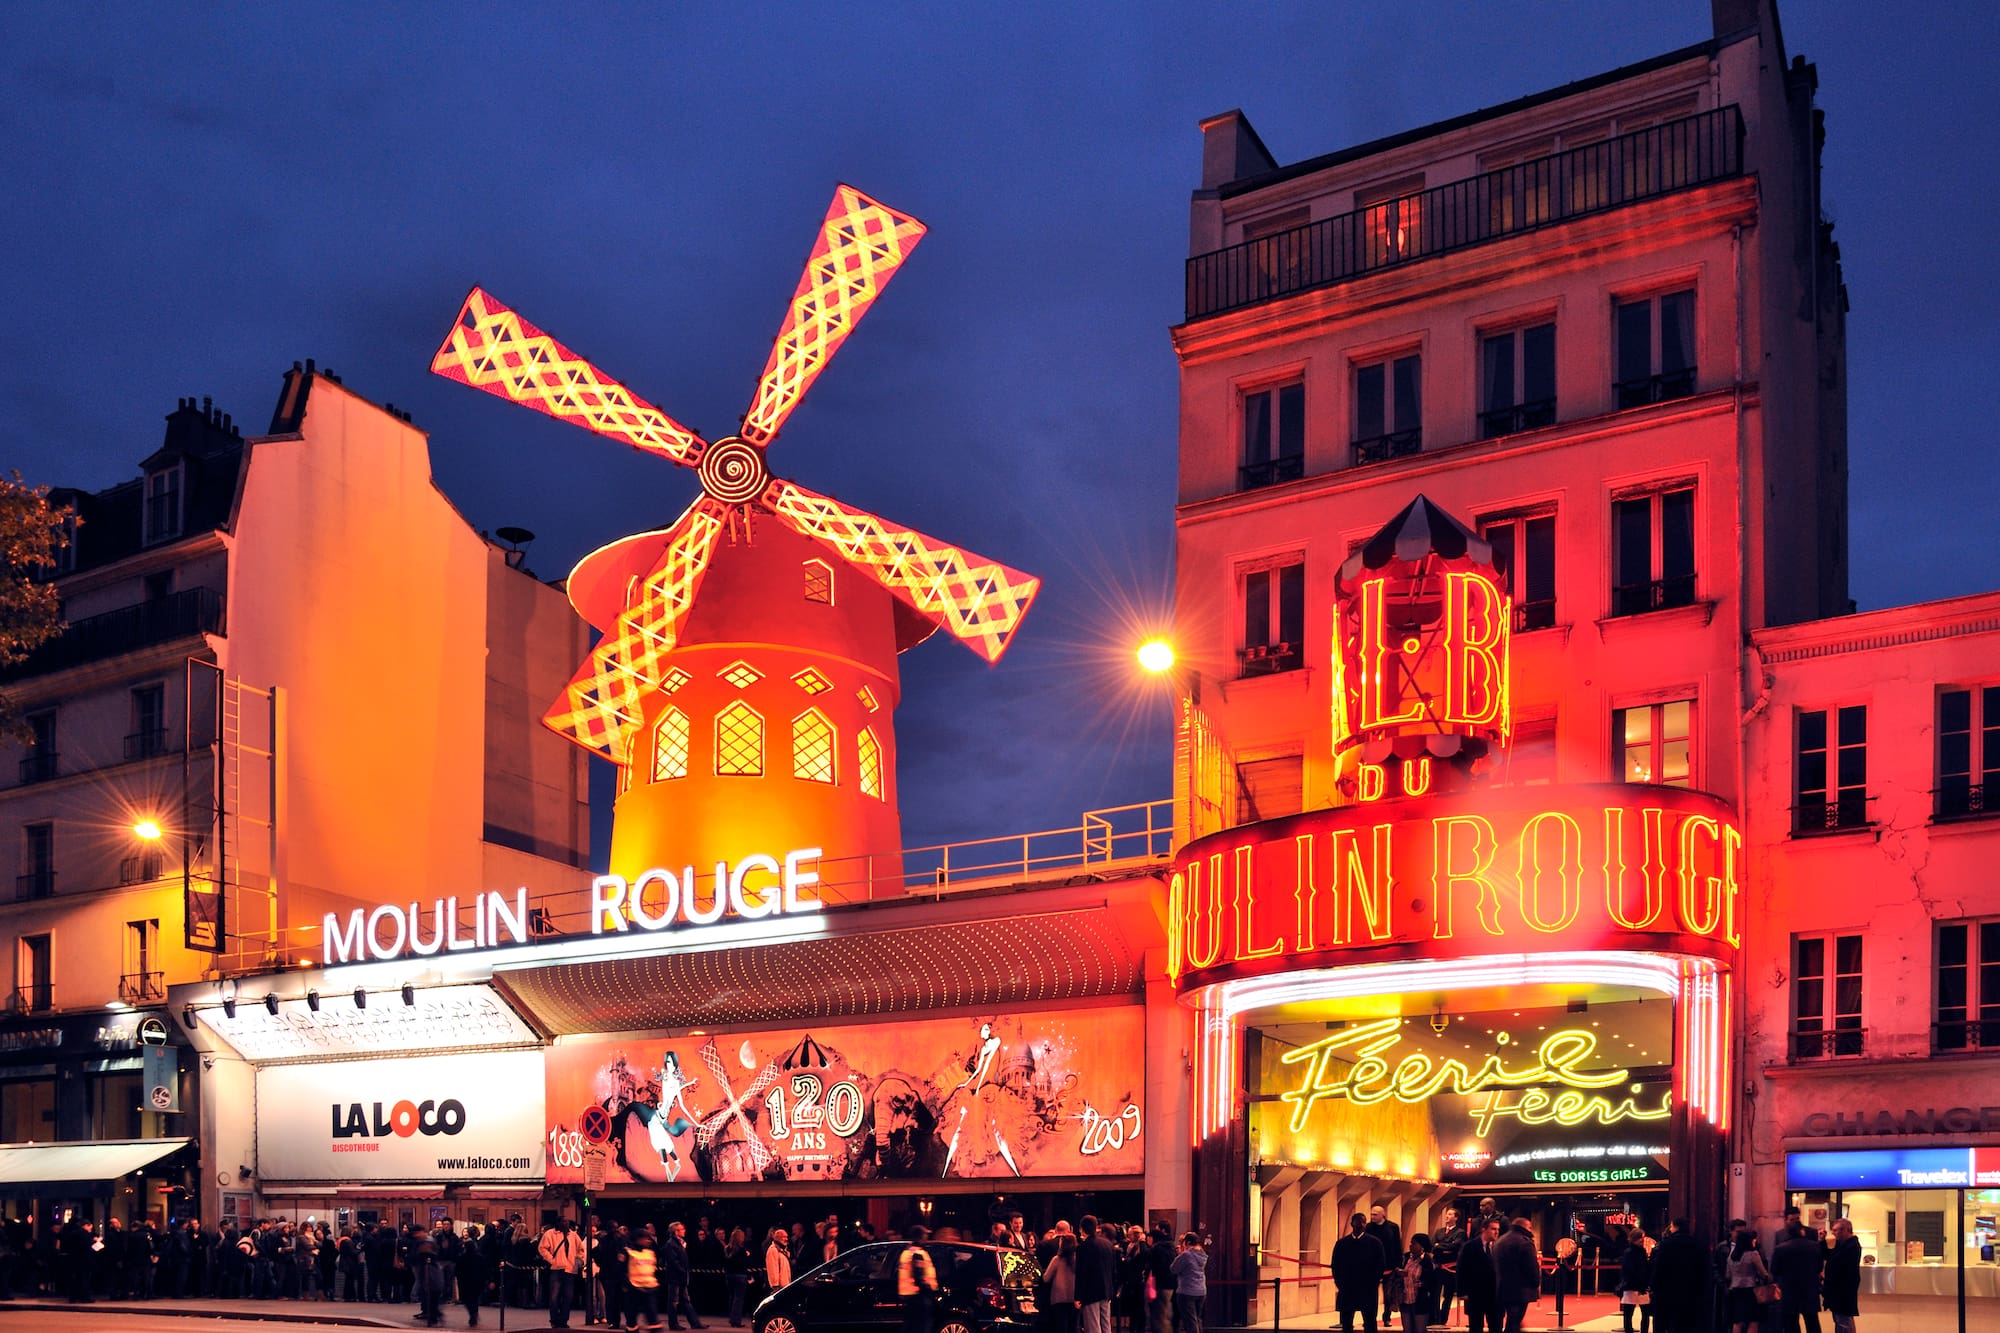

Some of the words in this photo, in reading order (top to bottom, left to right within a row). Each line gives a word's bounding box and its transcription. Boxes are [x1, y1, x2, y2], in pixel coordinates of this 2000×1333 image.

[1358, 758, 1430, 801] DU
[1431, 805, 1741, 949] ROUGE
[323, 886, 529, 964] MOULIN
[592, 848, 824, 935] ROUGE
[332, 1103, 370, 1138] LA
[373, 1099, 466, 1138] LOCO
[765, 1074, 864, 1140] 120
[1803, 1106, 2000, 1137] CHANGE
[791, 1132, 826, 1151] ANS
[1081, 1103, 1141, 1154] 2009
[332, 1143, 380, 1152] DISCOTHEQUE
[437, 1156, 530, 1169] www.laloco.com
[1534, 1169, 1556, 1182] LES
[1560, 1168, 1608, 1183] DORISS
[1610, 1167, 1649, 1182] GIRLS
[1898, 1169, 1967, 1185] Travelex
